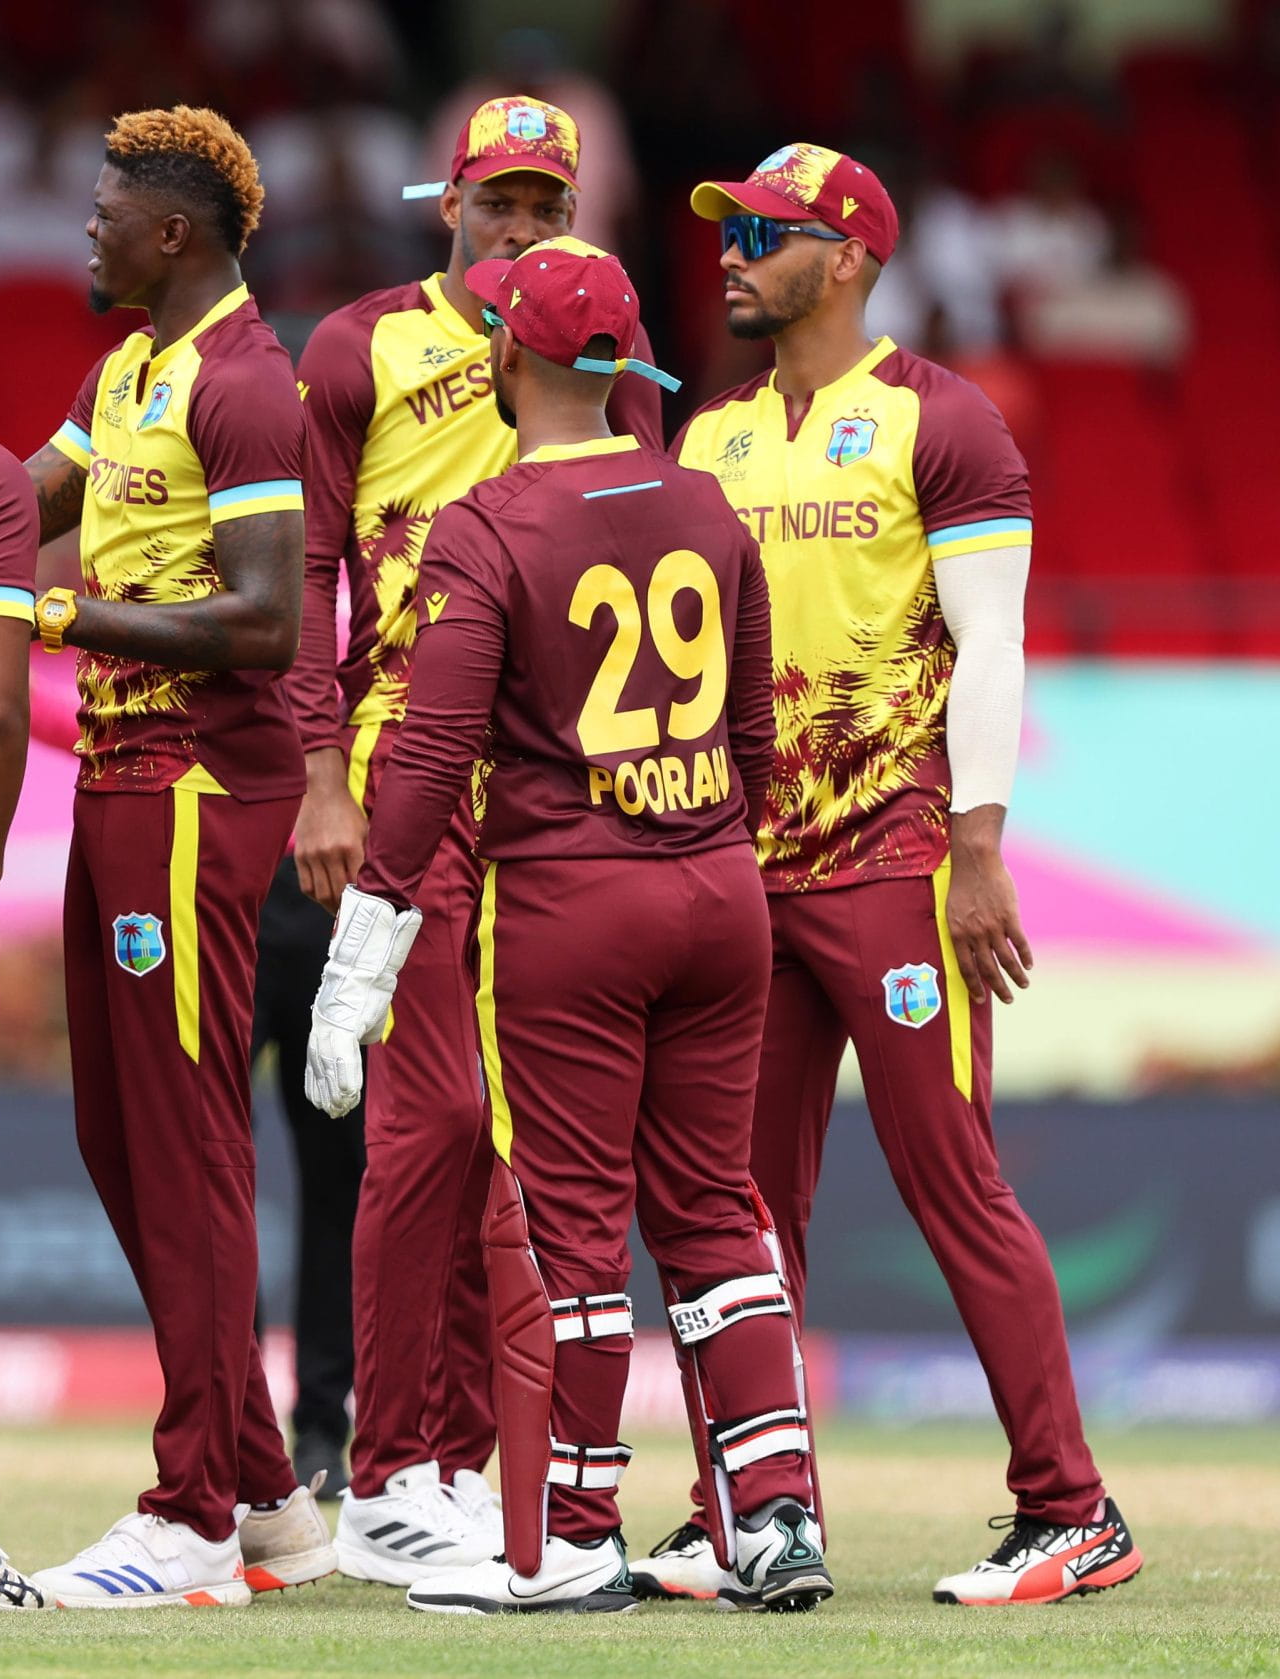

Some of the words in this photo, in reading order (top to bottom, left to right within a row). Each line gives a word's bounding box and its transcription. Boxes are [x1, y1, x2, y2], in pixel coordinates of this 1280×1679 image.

[735, 506, 774, 544] ST
[781, 501, 879, 541] INDIES
[568, 549, 727, 756] 29
[588, 746, 730, 816] POORAN
